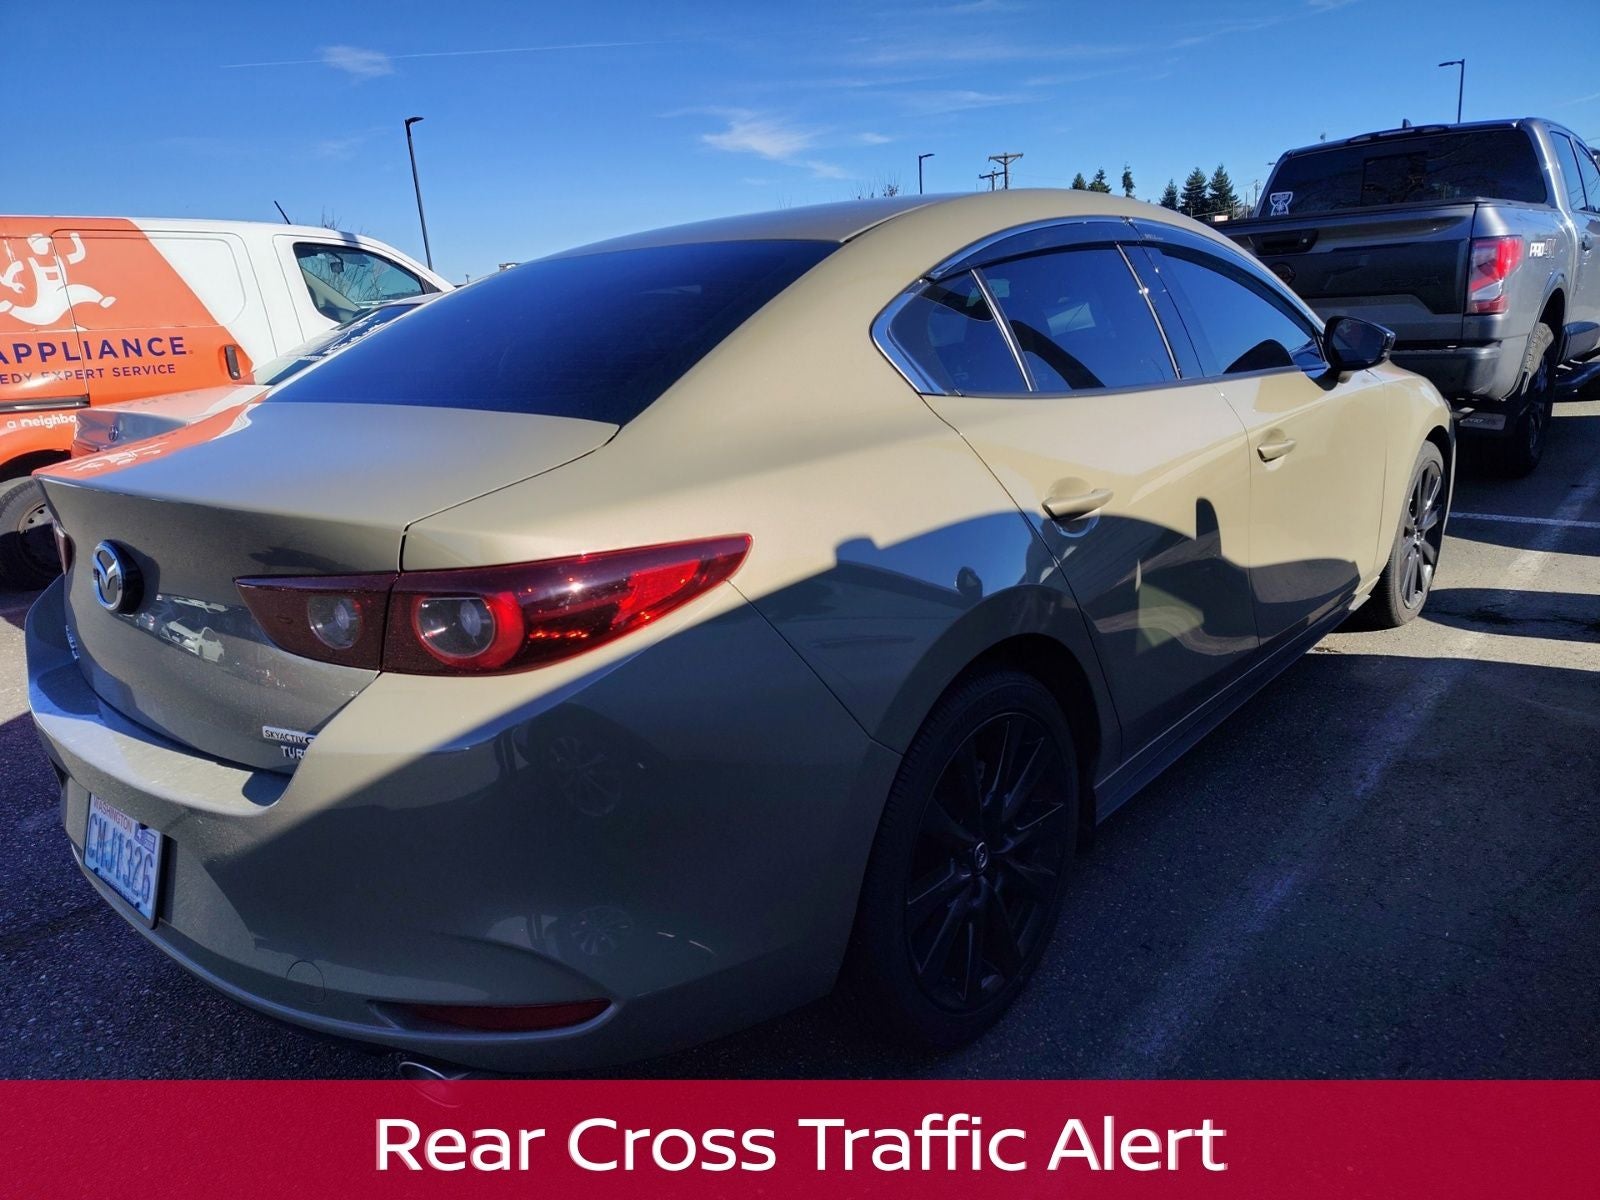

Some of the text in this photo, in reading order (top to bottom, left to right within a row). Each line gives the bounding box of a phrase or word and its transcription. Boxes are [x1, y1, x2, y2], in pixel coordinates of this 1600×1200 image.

[41, 368, 104, 381] EXPERT
[112, 364, 176, 378] SERVICE
[94, 796, 133, 833] WASHINGTON
